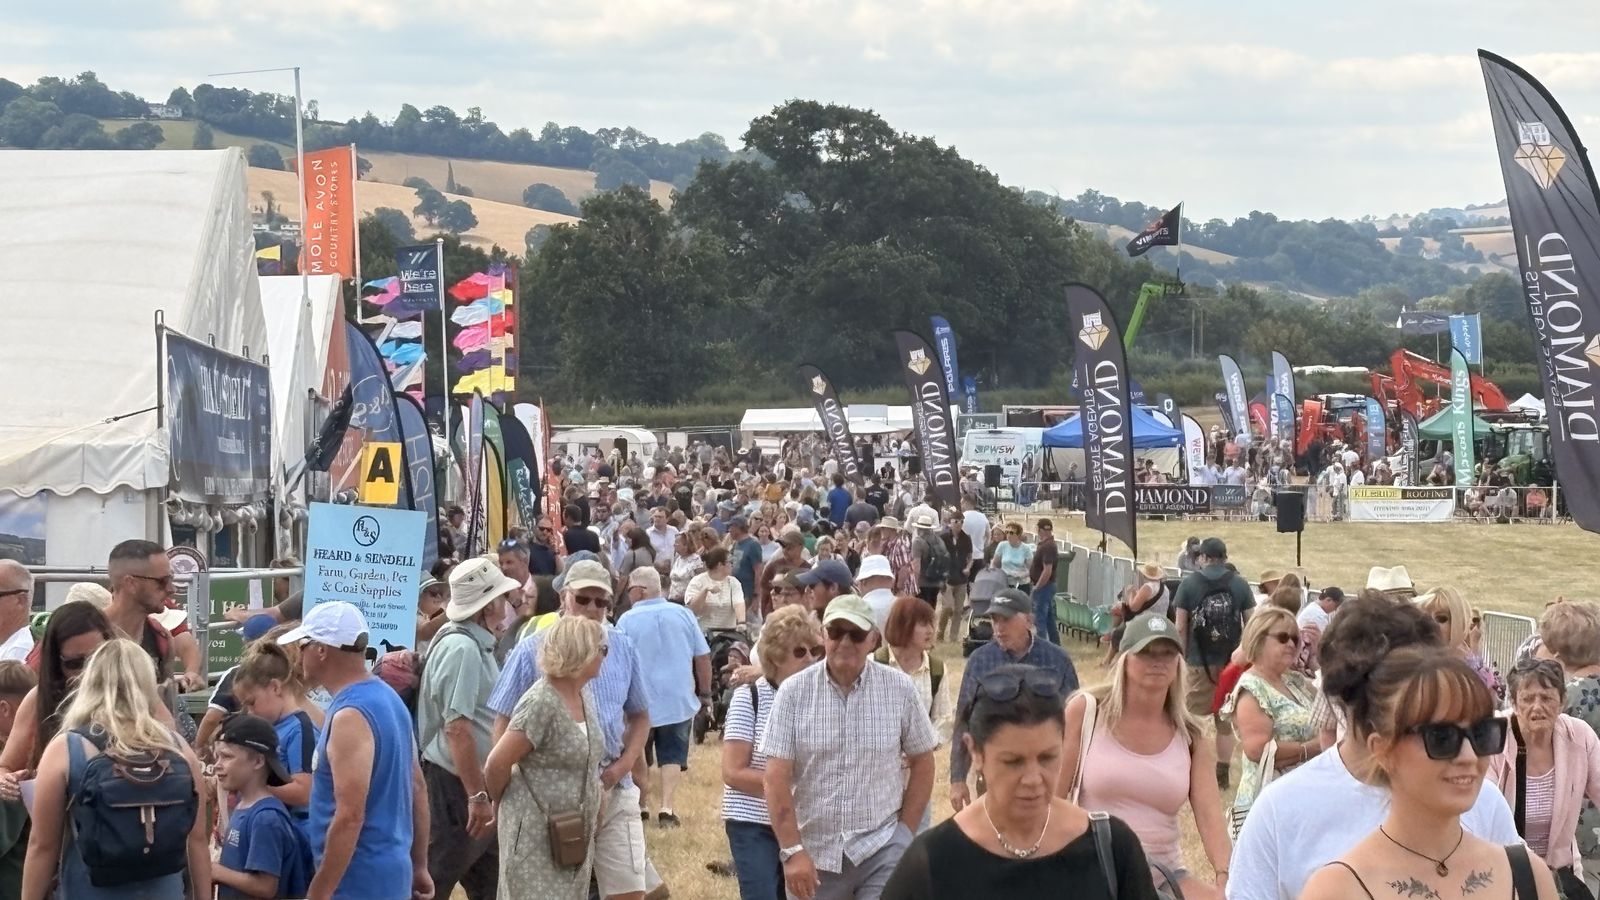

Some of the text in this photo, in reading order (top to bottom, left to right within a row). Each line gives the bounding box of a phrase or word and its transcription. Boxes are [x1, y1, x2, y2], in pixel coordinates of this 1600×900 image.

[311, 159, 327, 273] MOLE AVON
[329, 161, 338, 268] COUNTRY STORES
[401, 269, 437, 280] We're
[404, 282, 434, 292] here
[941, 337, 955, 393] POLARIS
[1452, 370, 1470, 414] Kings
[366, 447, 394, 484] A
[1406, 489, 1448, 498] ROOFING
[313, 548, 416, 567] HEARD & SENDELL
[318, 565, 408, 583] Farm, Garden, Pet
[321, 581, 402, 599] & Coal Supplies
